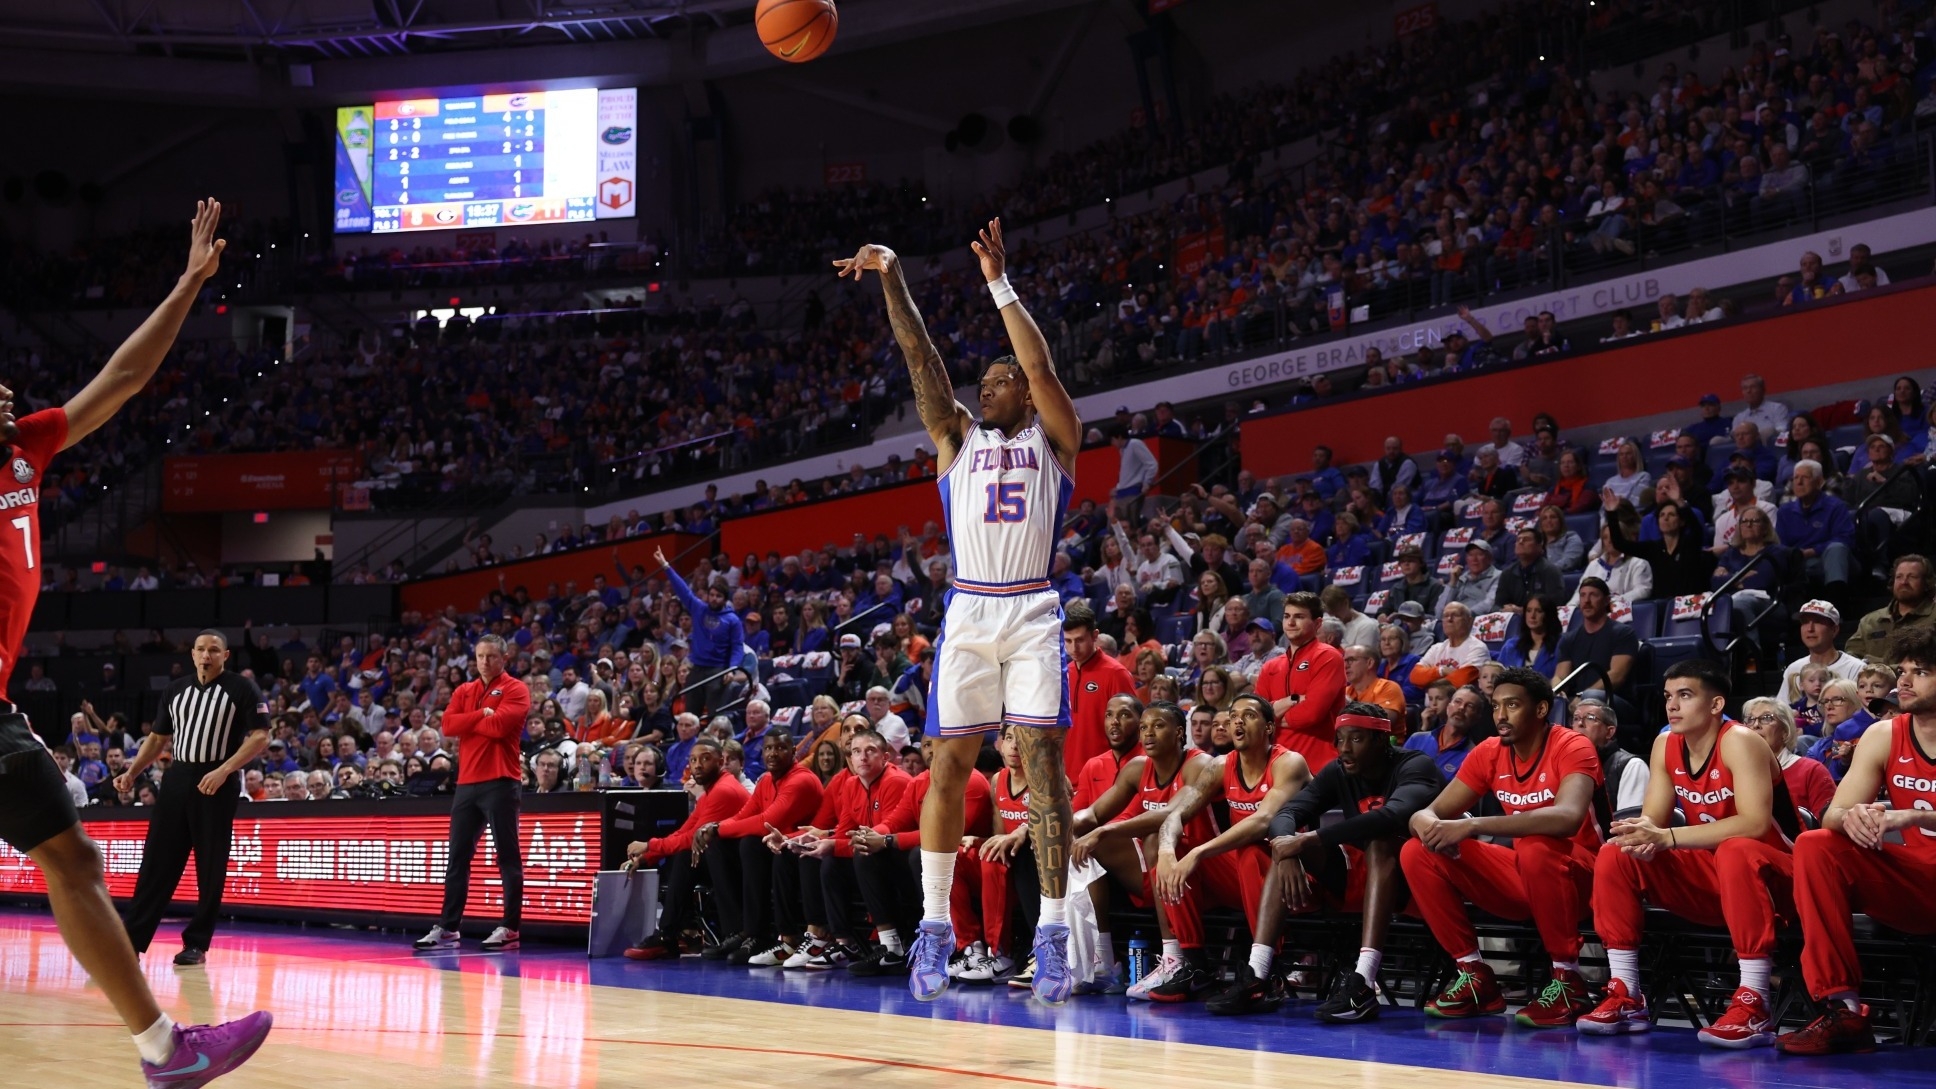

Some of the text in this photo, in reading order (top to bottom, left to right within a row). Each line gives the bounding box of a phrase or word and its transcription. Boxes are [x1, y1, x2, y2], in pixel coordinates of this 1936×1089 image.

[1399, 7, 1432, 35] 225
[503, 111, 512, 123] 4
[504, 125, 511, 137] 1
[525, 124, 534, 136] 2
[503, 141, 511, 153] 2
[525, 140, 533, 152] 3
[389, 148, 398, 160] 2
[411, 147, 420, 159] 2
[514, 155, 521, 167] 1
[600, 160, 633, 172] LAW
[400, 162, 409, 174] 2
[829, 166, 862, 182] 223
[401, 176, 409, 189] 1
[513, 170, 521, 183] 1
[399, 191, 408, 204] 4
[513, 185, 521, 197] 1
[1228, 355, 1307, 387] GEORGE
[1498, 295, 1580, 331] COURT
[1593, 279, 1660, 309] CLUB
[970, 445, 1039, 473] FLOIDA
[0, 486, 39, 509] ORGI
[984, 482, 1027, 523] 15
[1496, 788, 1555, 806] GEORGIA
[1227, 799, 1263, 811] GEORG
[1000, 809, 1028, 821] GEORG
[276, 839, 335, 881] CUBAN
[337, 839, 386, 885] FOOD
[389, 840, 427, 887] FOR
[1135, 948, 1143, 982] POWERAD
